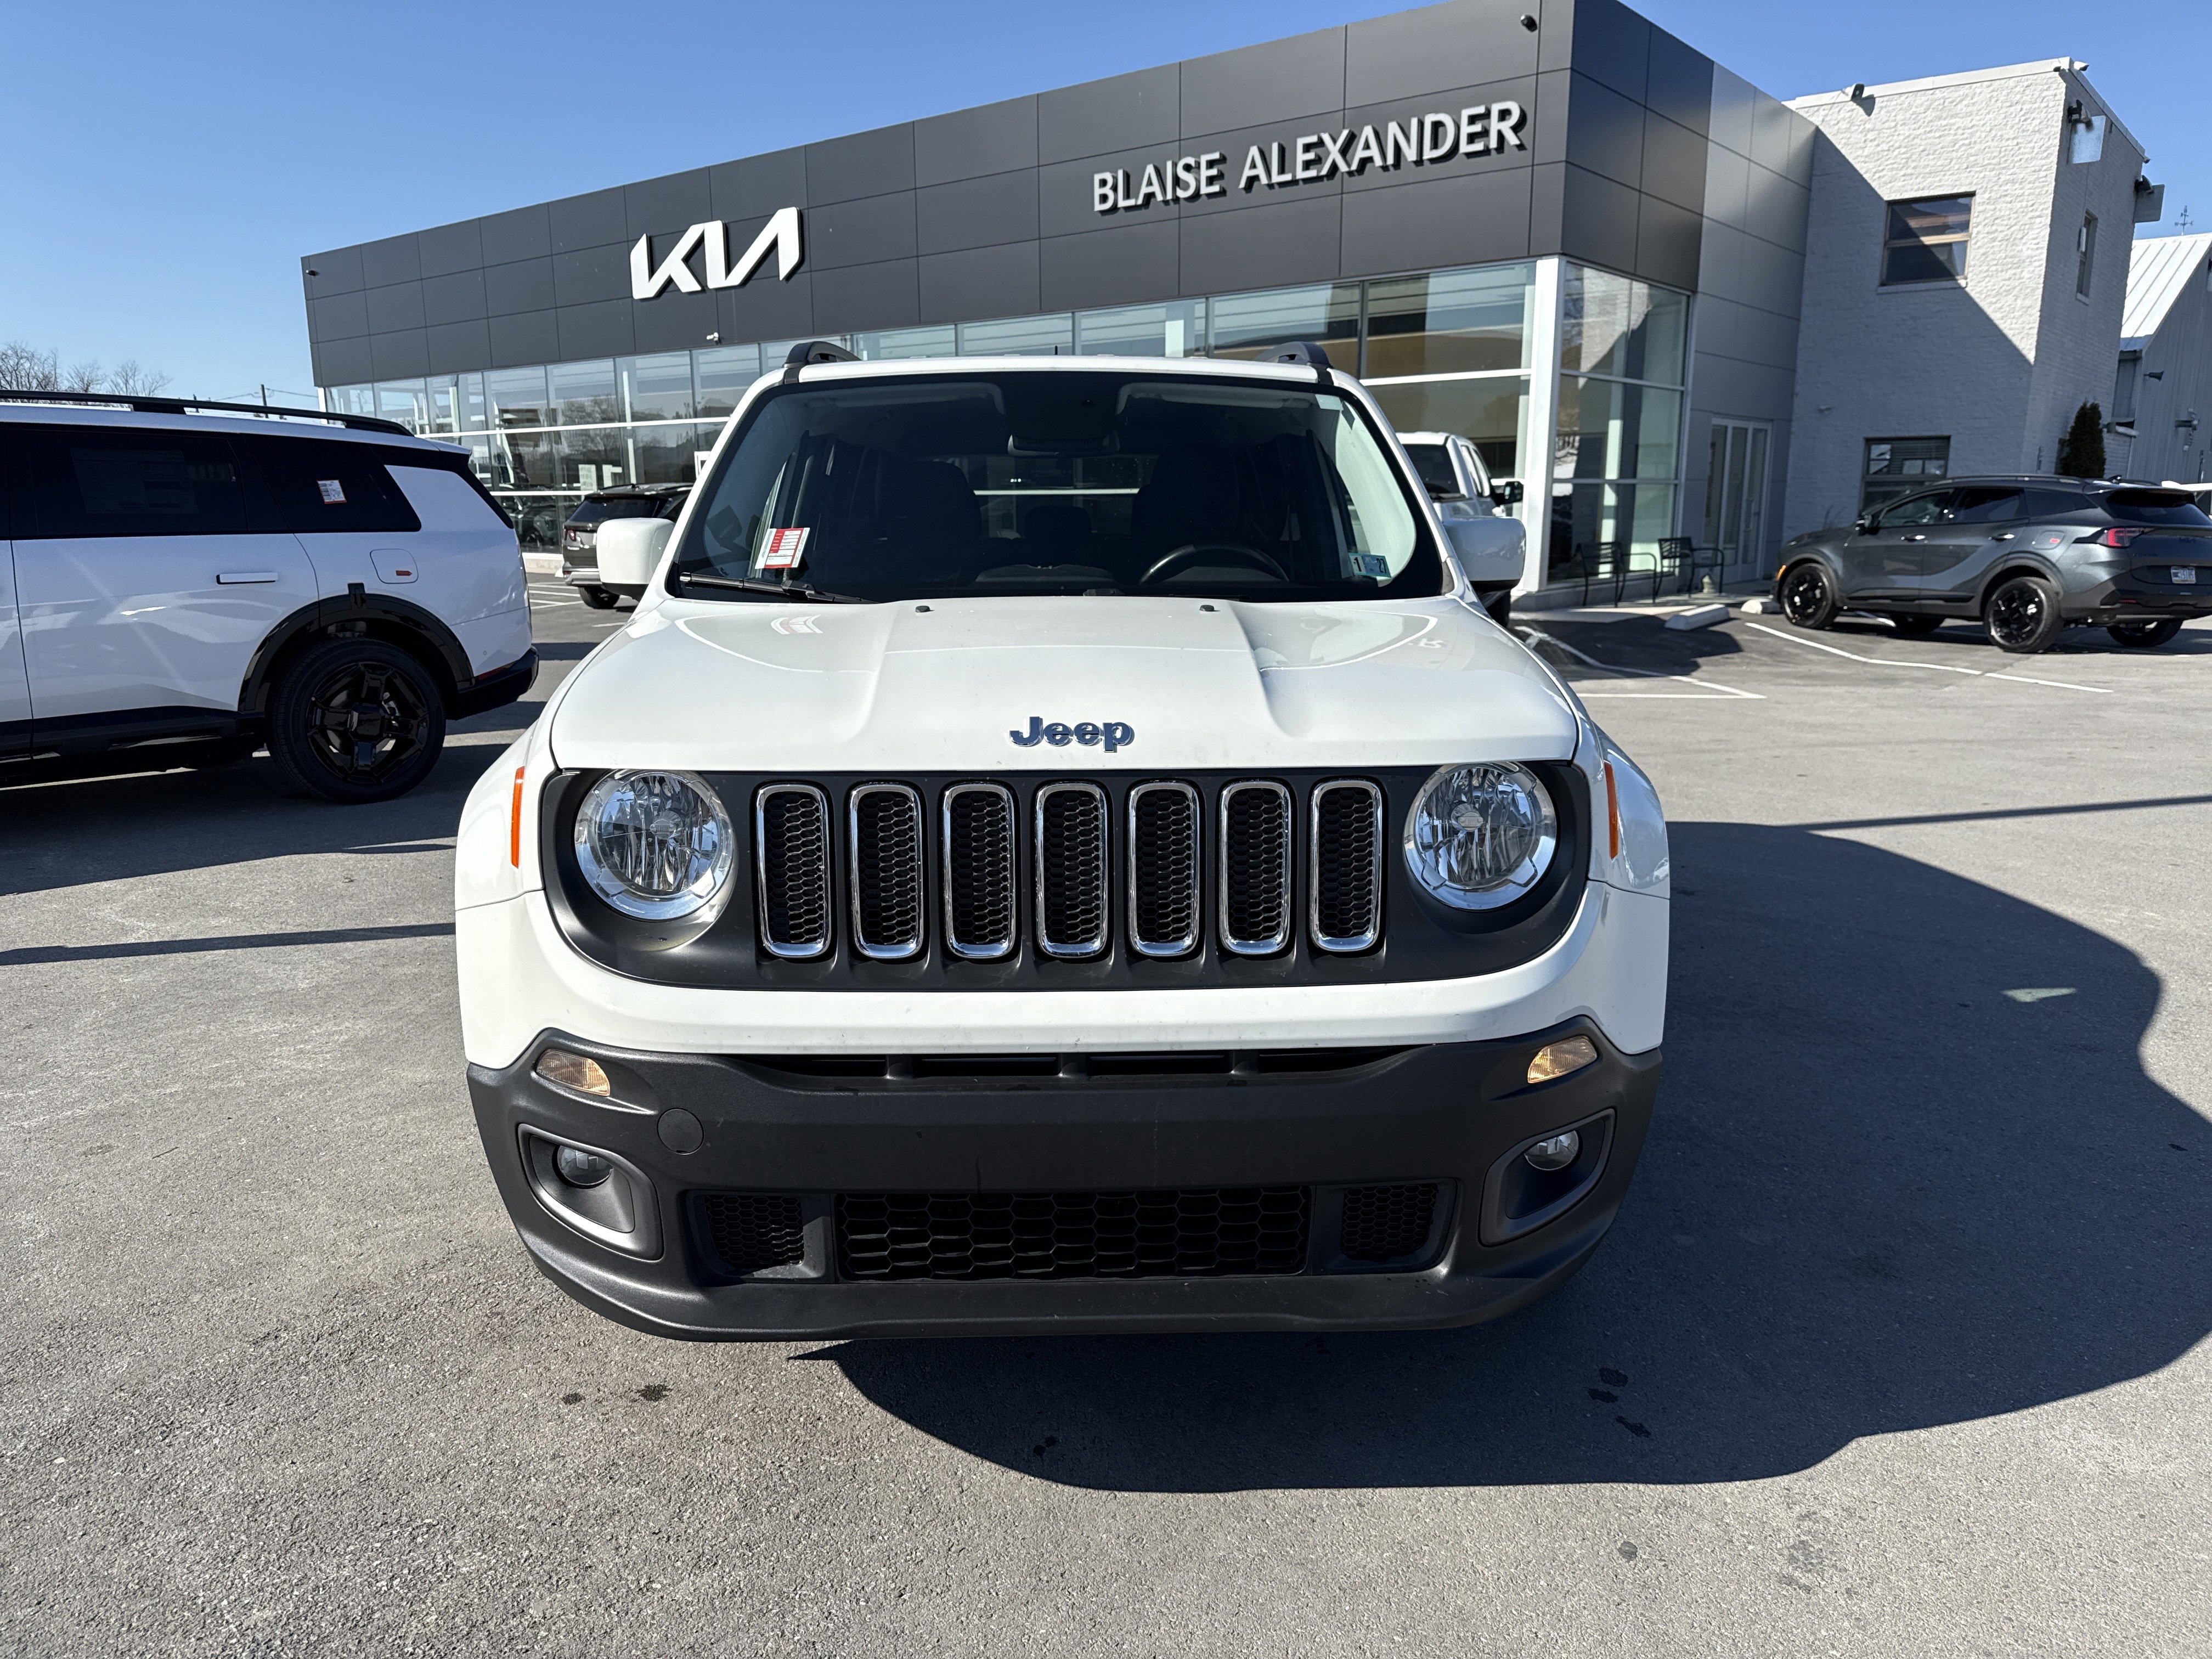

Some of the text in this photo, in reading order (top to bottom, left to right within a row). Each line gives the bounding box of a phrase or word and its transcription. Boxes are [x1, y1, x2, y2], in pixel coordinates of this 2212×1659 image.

[1093, 100, 1525, 213] BLAISE ALEXANDER
[630, 206, 802, 300] KIA
[1009, 716, 1132, 753] Jeep
